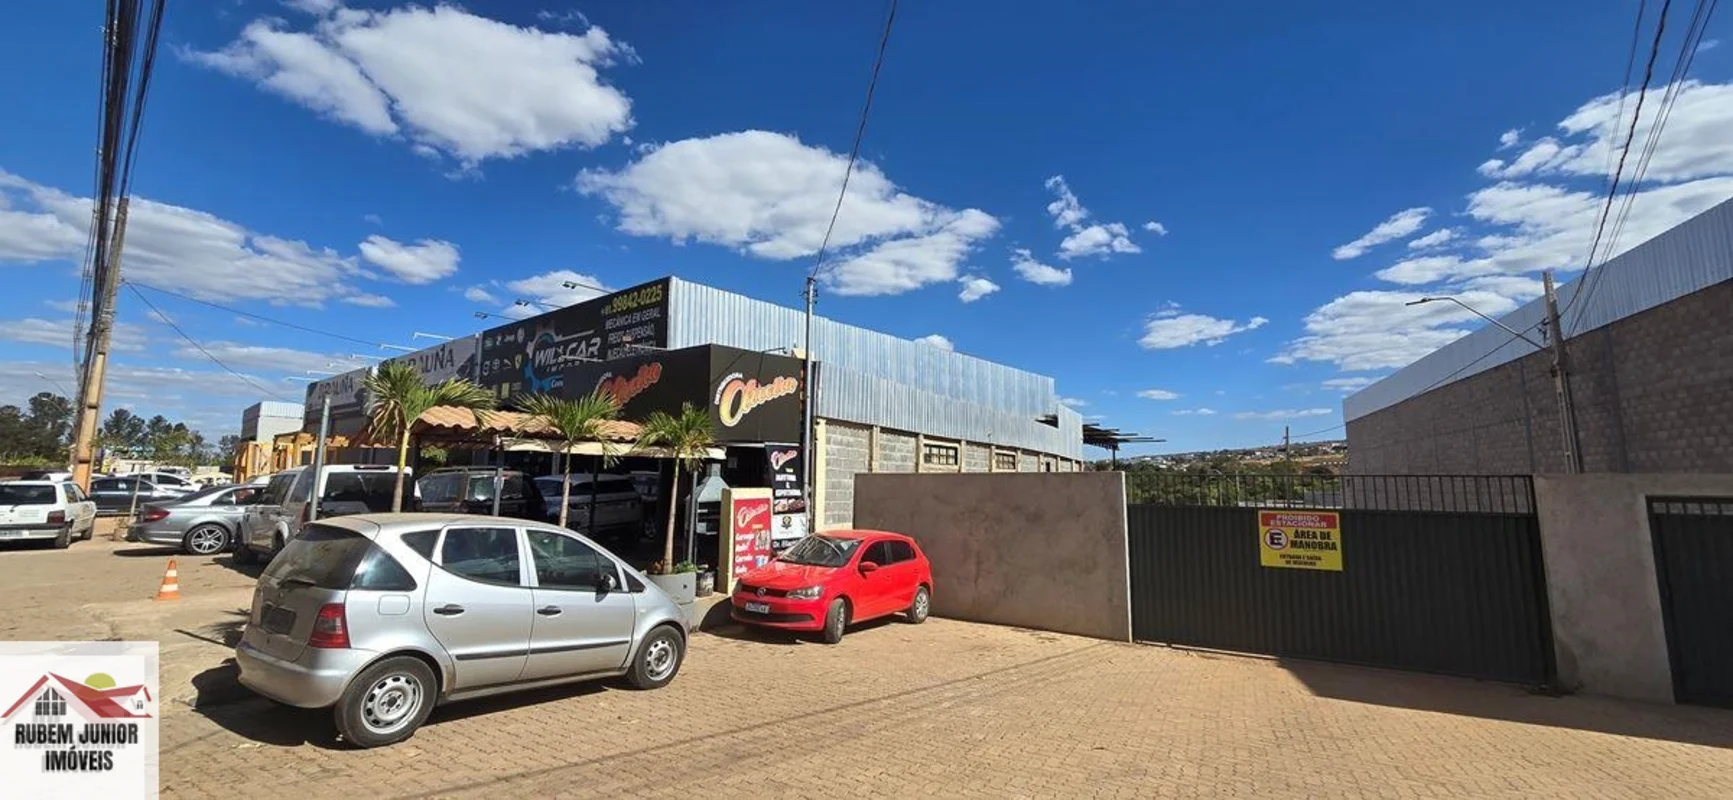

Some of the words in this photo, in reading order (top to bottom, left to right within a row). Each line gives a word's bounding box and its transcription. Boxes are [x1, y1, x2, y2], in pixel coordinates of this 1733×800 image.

[641, 306, 662, 322] GERAL
[1270, 520, 1328, 528] ESTACIONAR
[1293, 529, 1317, 540] ÁREA
[1319, 531, 1332, 541] DE
[1290, 540, 1338, 551] MANOBRA
